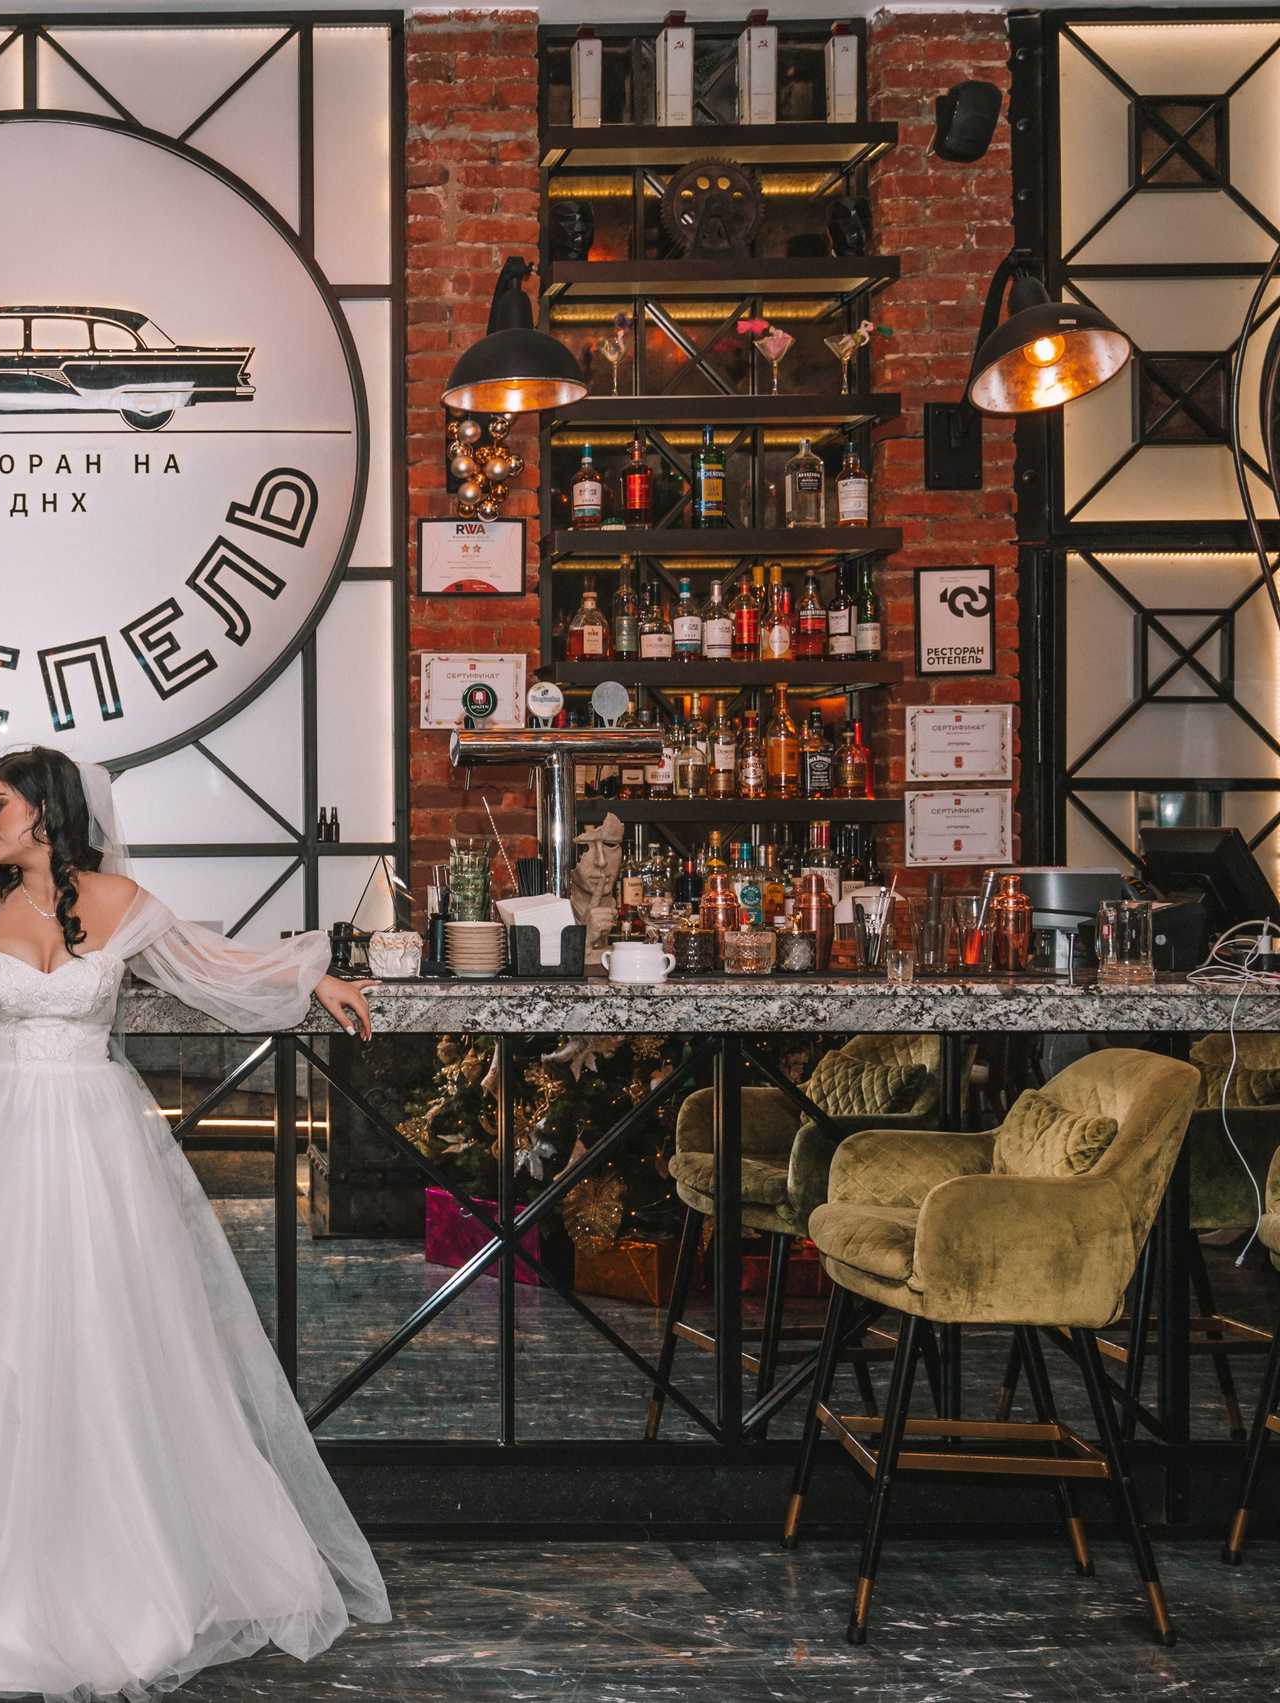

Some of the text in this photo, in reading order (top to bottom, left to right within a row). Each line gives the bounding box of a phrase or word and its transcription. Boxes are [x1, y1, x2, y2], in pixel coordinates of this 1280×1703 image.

[134, 453, 181, 474] НА
[456, 524, 486, 535] RWA
[926, 646, 984, 656] РЕСТОРАН
[926, 655, 983, 665] ОТТЕПЕЛЬ
